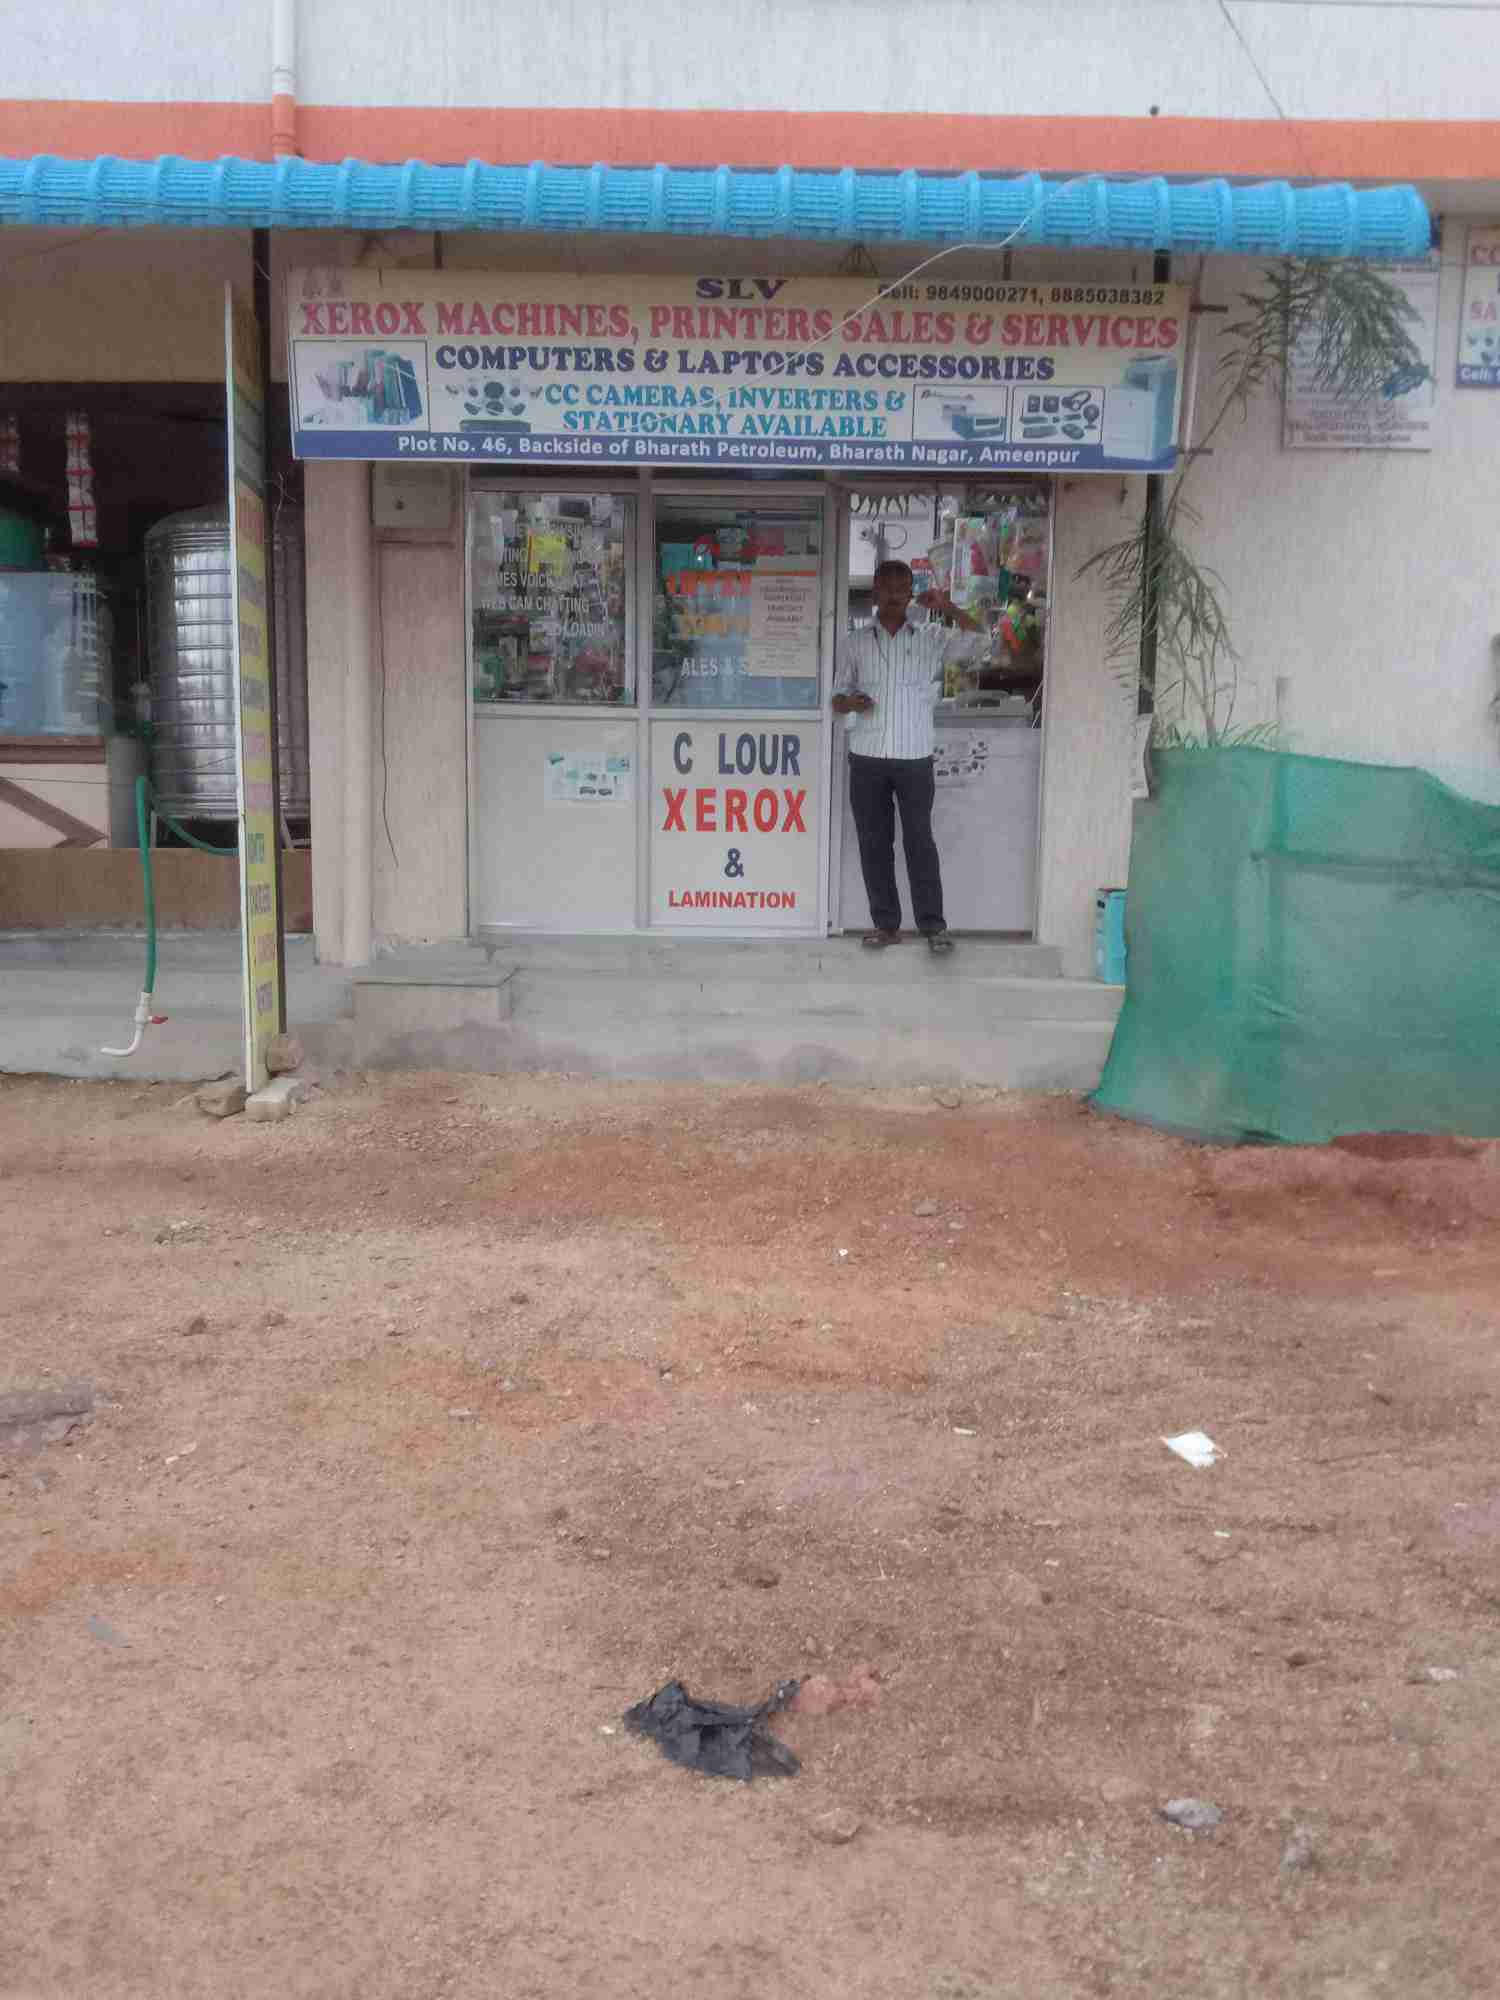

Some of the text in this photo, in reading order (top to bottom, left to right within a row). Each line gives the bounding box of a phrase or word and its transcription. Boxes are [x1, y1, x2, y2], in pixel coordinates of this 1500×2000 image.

[696, 278, 788, 300] SLV
[299, 303, 1179, 348] XEROX MACHINES, PRINTERS SALES & SERVICES
[436, 345, 1055, 380] COMPUTERS & LAPTOPS ACCESSORIES
[546, 384, 580, 405] CC
[586, 384, 721, 410] CAMERAS,
[885, 389, 906, 412] &
[562, 410, 887, 437] STATIONARY AVAILABLE
[398, 436, 1080, 465] Plot No. 46, Backside of Bharath Petroleum, Bharath Nagar, Ameenpur
[662, 787, 807, 833] XEROX
[724, 848, 744, 878] &
[668, 890, 796, 909] LAMINATION
